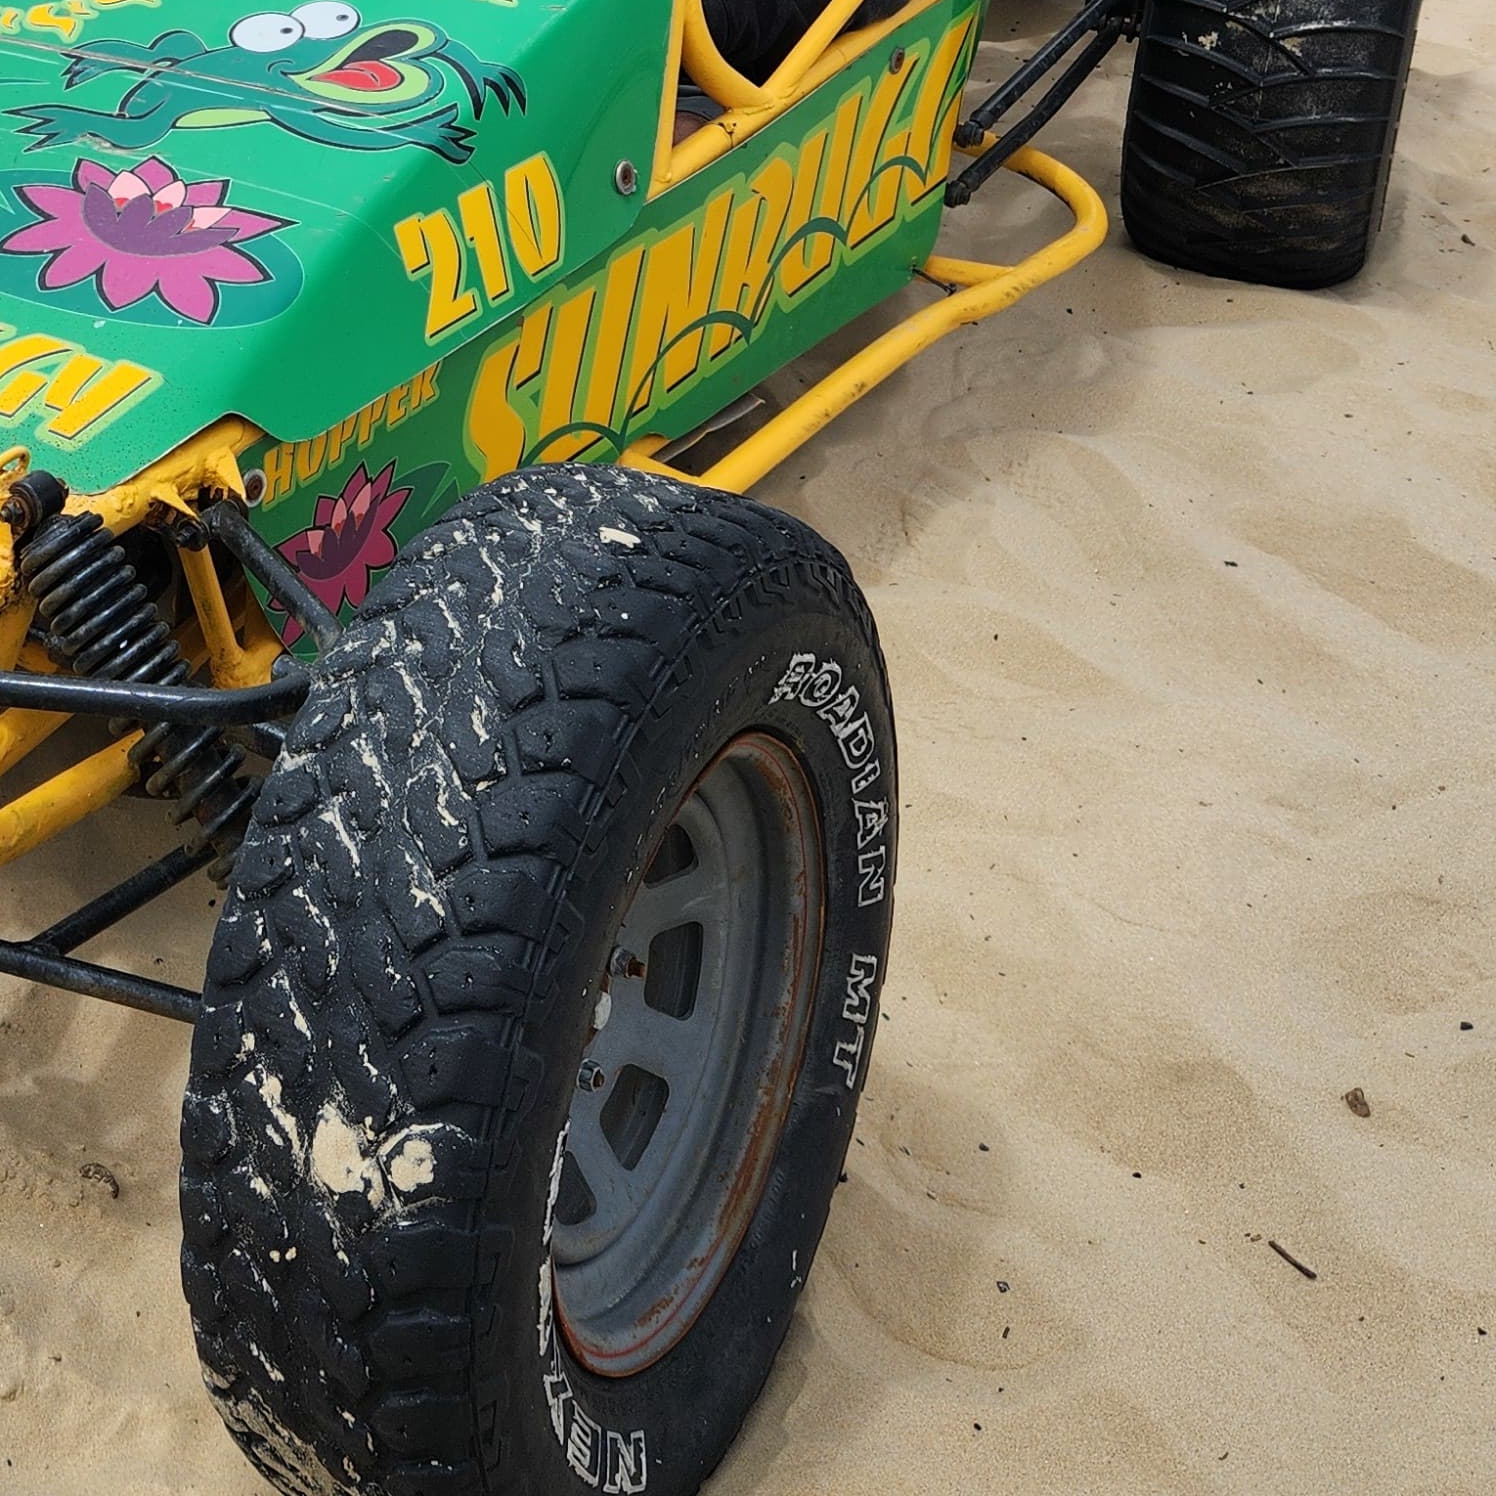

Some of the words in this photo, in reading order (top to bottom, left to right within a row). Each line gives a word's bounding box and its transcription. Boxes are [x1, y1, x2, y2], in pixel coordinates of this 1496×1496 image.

[393, 152, 566, 342] 210
[769, 652, 891, 908] ROADIAN
[833, 953, 878, 1089] MT
